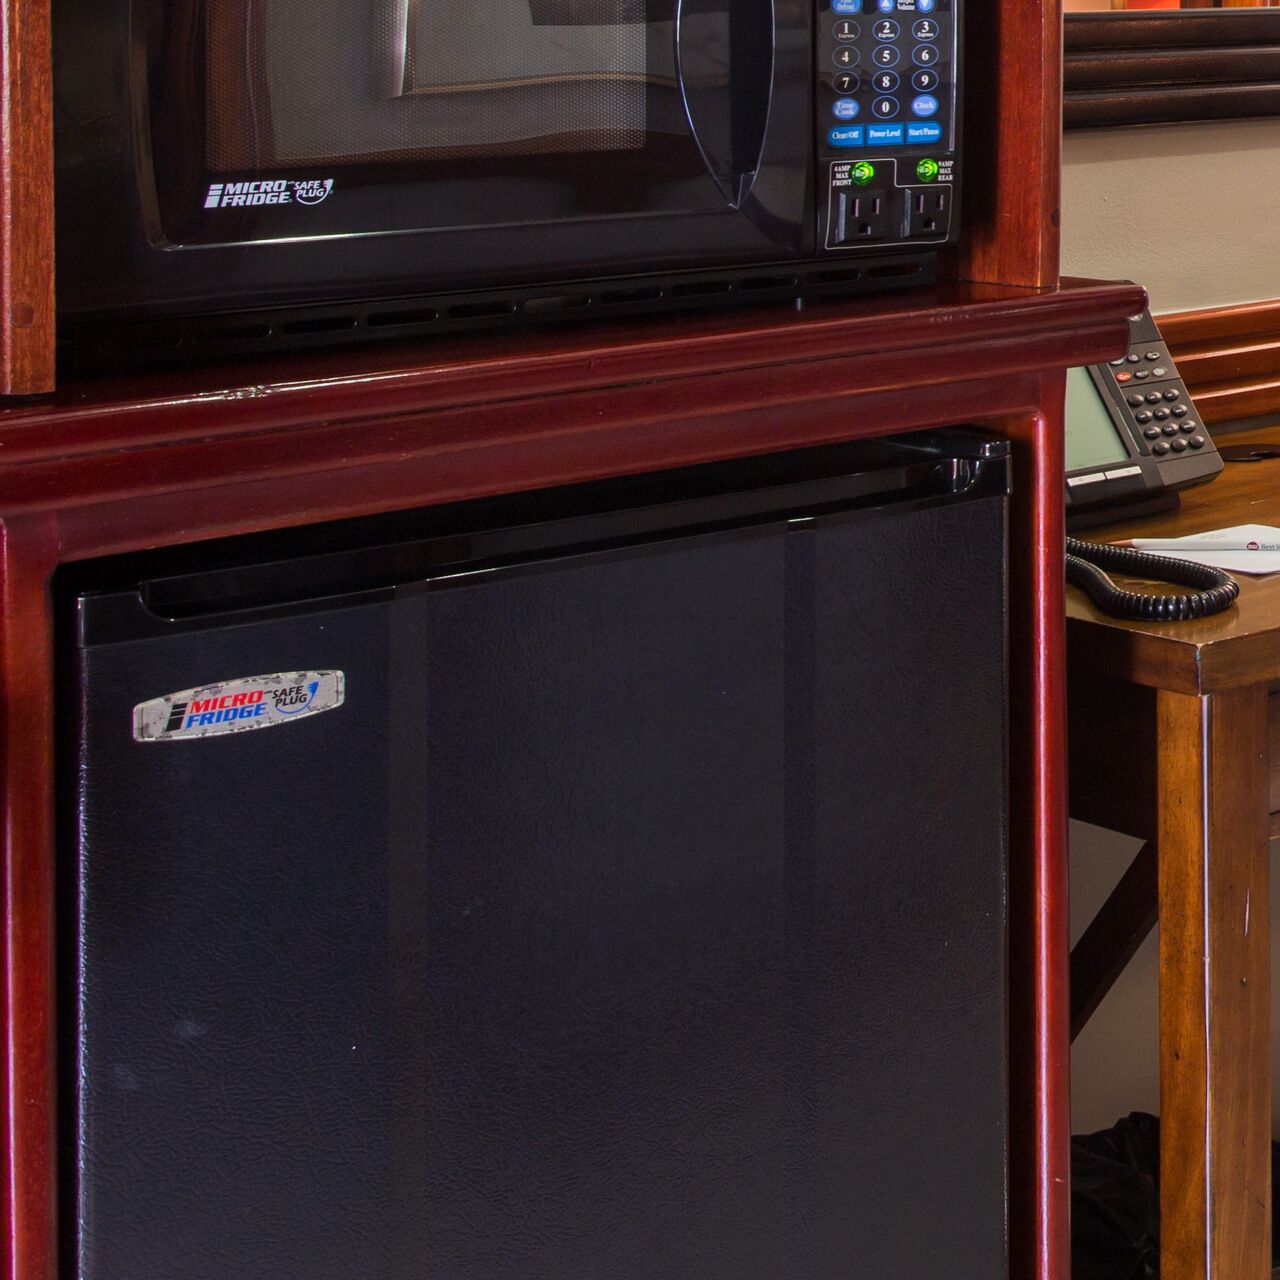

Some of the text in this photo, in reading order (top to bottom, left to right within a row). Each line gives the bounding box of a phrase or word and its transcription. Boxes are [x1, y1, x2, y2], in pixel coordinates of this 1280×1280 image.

[843, 22, 849, 34] 1
[882, 21, 890, 33] 2
[921, 21, 929, 33] 3
[842, 51, 849, 62] 4
[882, 50, 890, 61] 5
[921, 49, 929, 61] 6
[842, 77, 850, 88] 7
[882, 75, 890, 87] 8
[921, 74, 929, 86] 9
[882, 101, 890, 113] 0
[224, 179, 288, 195] MICRO
[293, 180, 320, 190] SAFE
[296, 188, 325, 198] PLUG
[220, 192, 291, 208] FRIDGE
[271, 685, 304, 700] SAFE
[189, 689, 264, 714] MICRO
[274, 693, 308, 708] PLUG
[185, 702, 268, 730] FRIDGE
